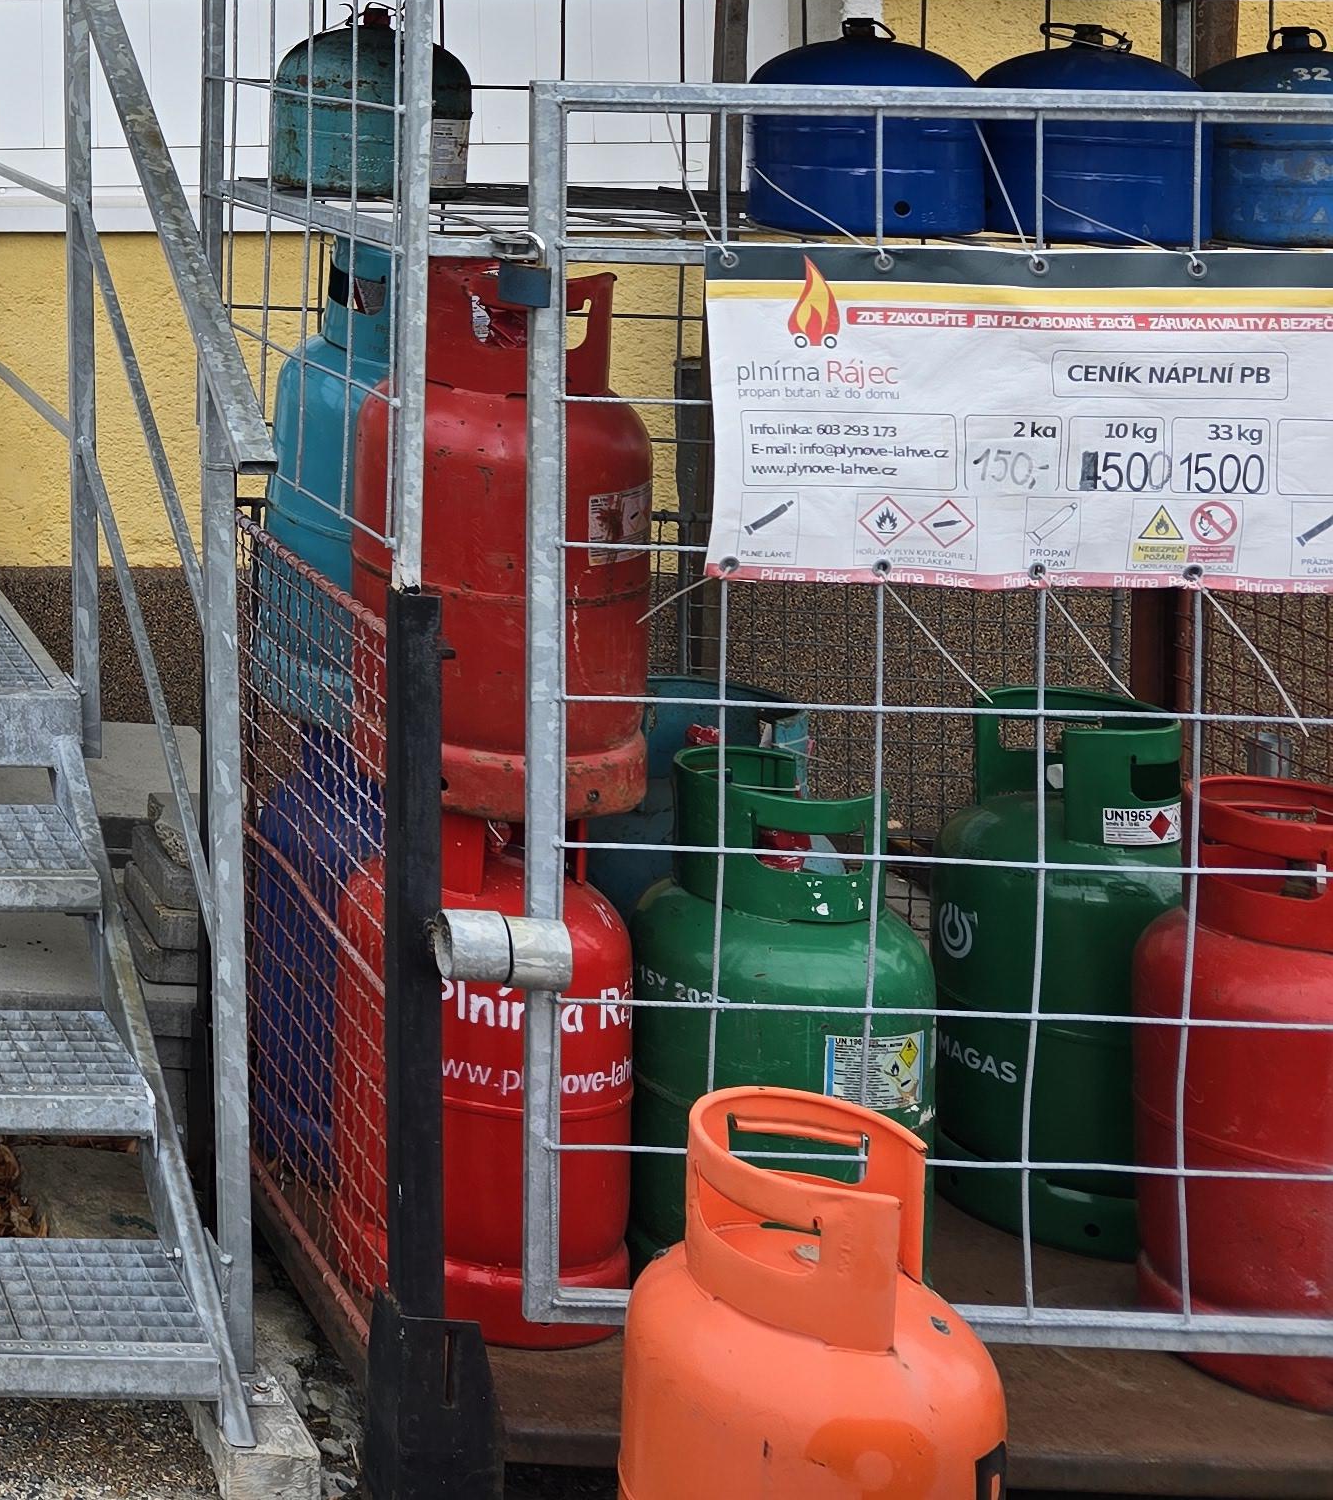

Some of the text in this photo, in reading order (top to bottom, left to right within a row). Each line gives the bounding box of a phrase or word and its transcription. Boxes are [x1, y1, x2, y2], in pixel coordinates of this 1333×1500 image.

[856, 311, 884, 324] ZDE
[887, 310, 967, 326] ZAKOUPÍTE
[973, 314, 998, 328] JEN
[1002, 314, 1095, 329] PLOMBOVANÉ
[1149, 314, 1207, 330] ZÁRUKA
[1209, 317, 1266, 330] KVALITY
[737, 359, 899, 389] plnírna Rájec
[1067, 362, 1271, 384] CENÍK NÁPLNÍ PB
[738, 387, 900, 400] propan butan až do domu
[816, 424, 841, 435] 603
[844, 425, 870, 436] 293
[873, 426, 897, 437] 173
[1013, 421, 1026, 438] 2
[1104, 422, 1158, 444] 10 kg
[1207, 424, 1263, 445] 33 kg
[800, 444, 949, 459] info@plynove-lahve.cz
[751, 463, 898, 477] www.plynove-lahve.cz
[1179, 452, 1265, 494] 1500
[1029, 548, 1071, 558] PROPAN
[760, 568, 852, 583] Plnírna Rájec
[935, 572, 975, 587] Rájec
[1235, 578, 1284, 594] Plnírna
[1104, 809, 1153, 822] UN1965
[441, 977, 584, 1033] Plníra
[849, 1038, 865, 1046] 196
